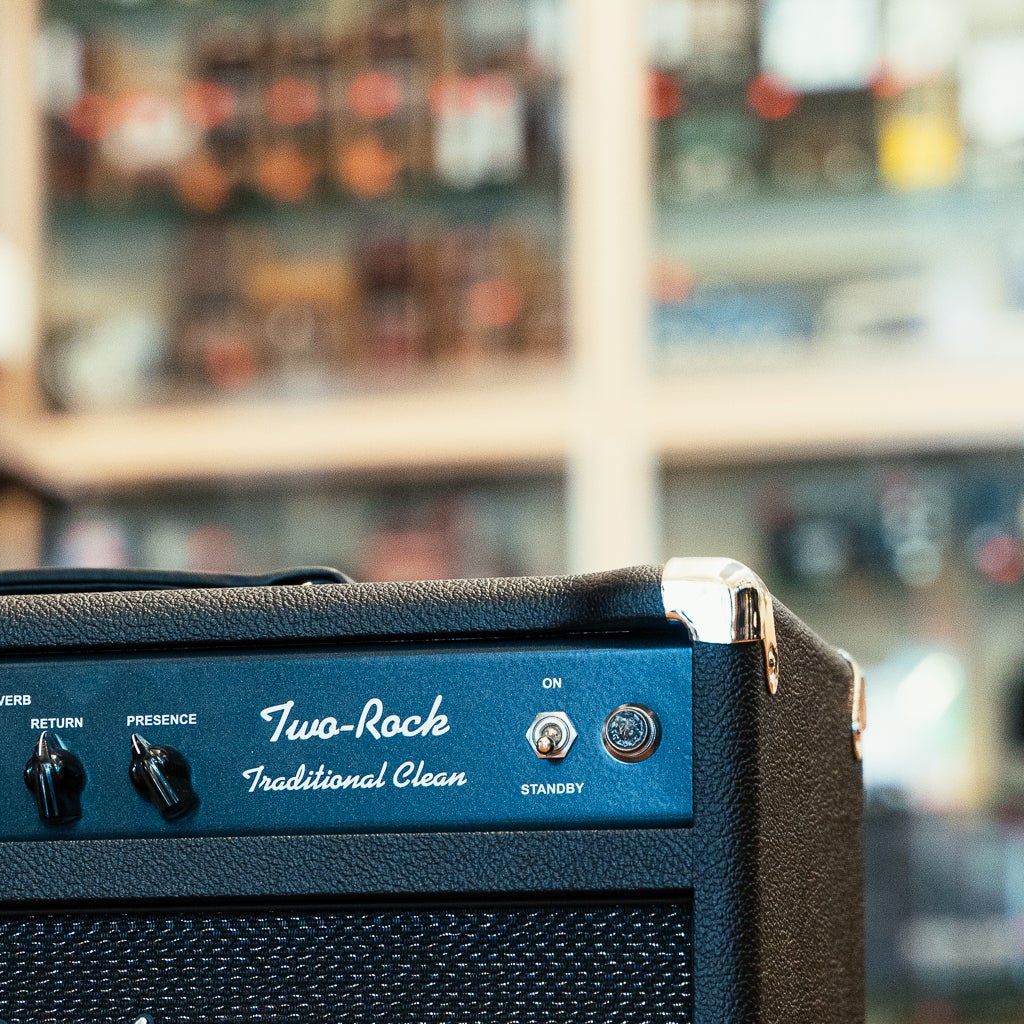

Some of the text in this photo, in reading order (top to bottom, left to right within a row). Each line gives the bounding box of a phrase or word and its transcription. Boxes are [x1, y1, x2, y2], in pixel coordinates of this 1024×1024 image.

[542, 677, 562, 690] ON
[29, 716, 84, 730] RETURN
[125, 712, 197, 728] PRESENCE
[260, 694, 451, 743] Two-Rock
[241, 760, 468, 794] Traditional Clean
[519, 781, 586, 796] STANDBY
